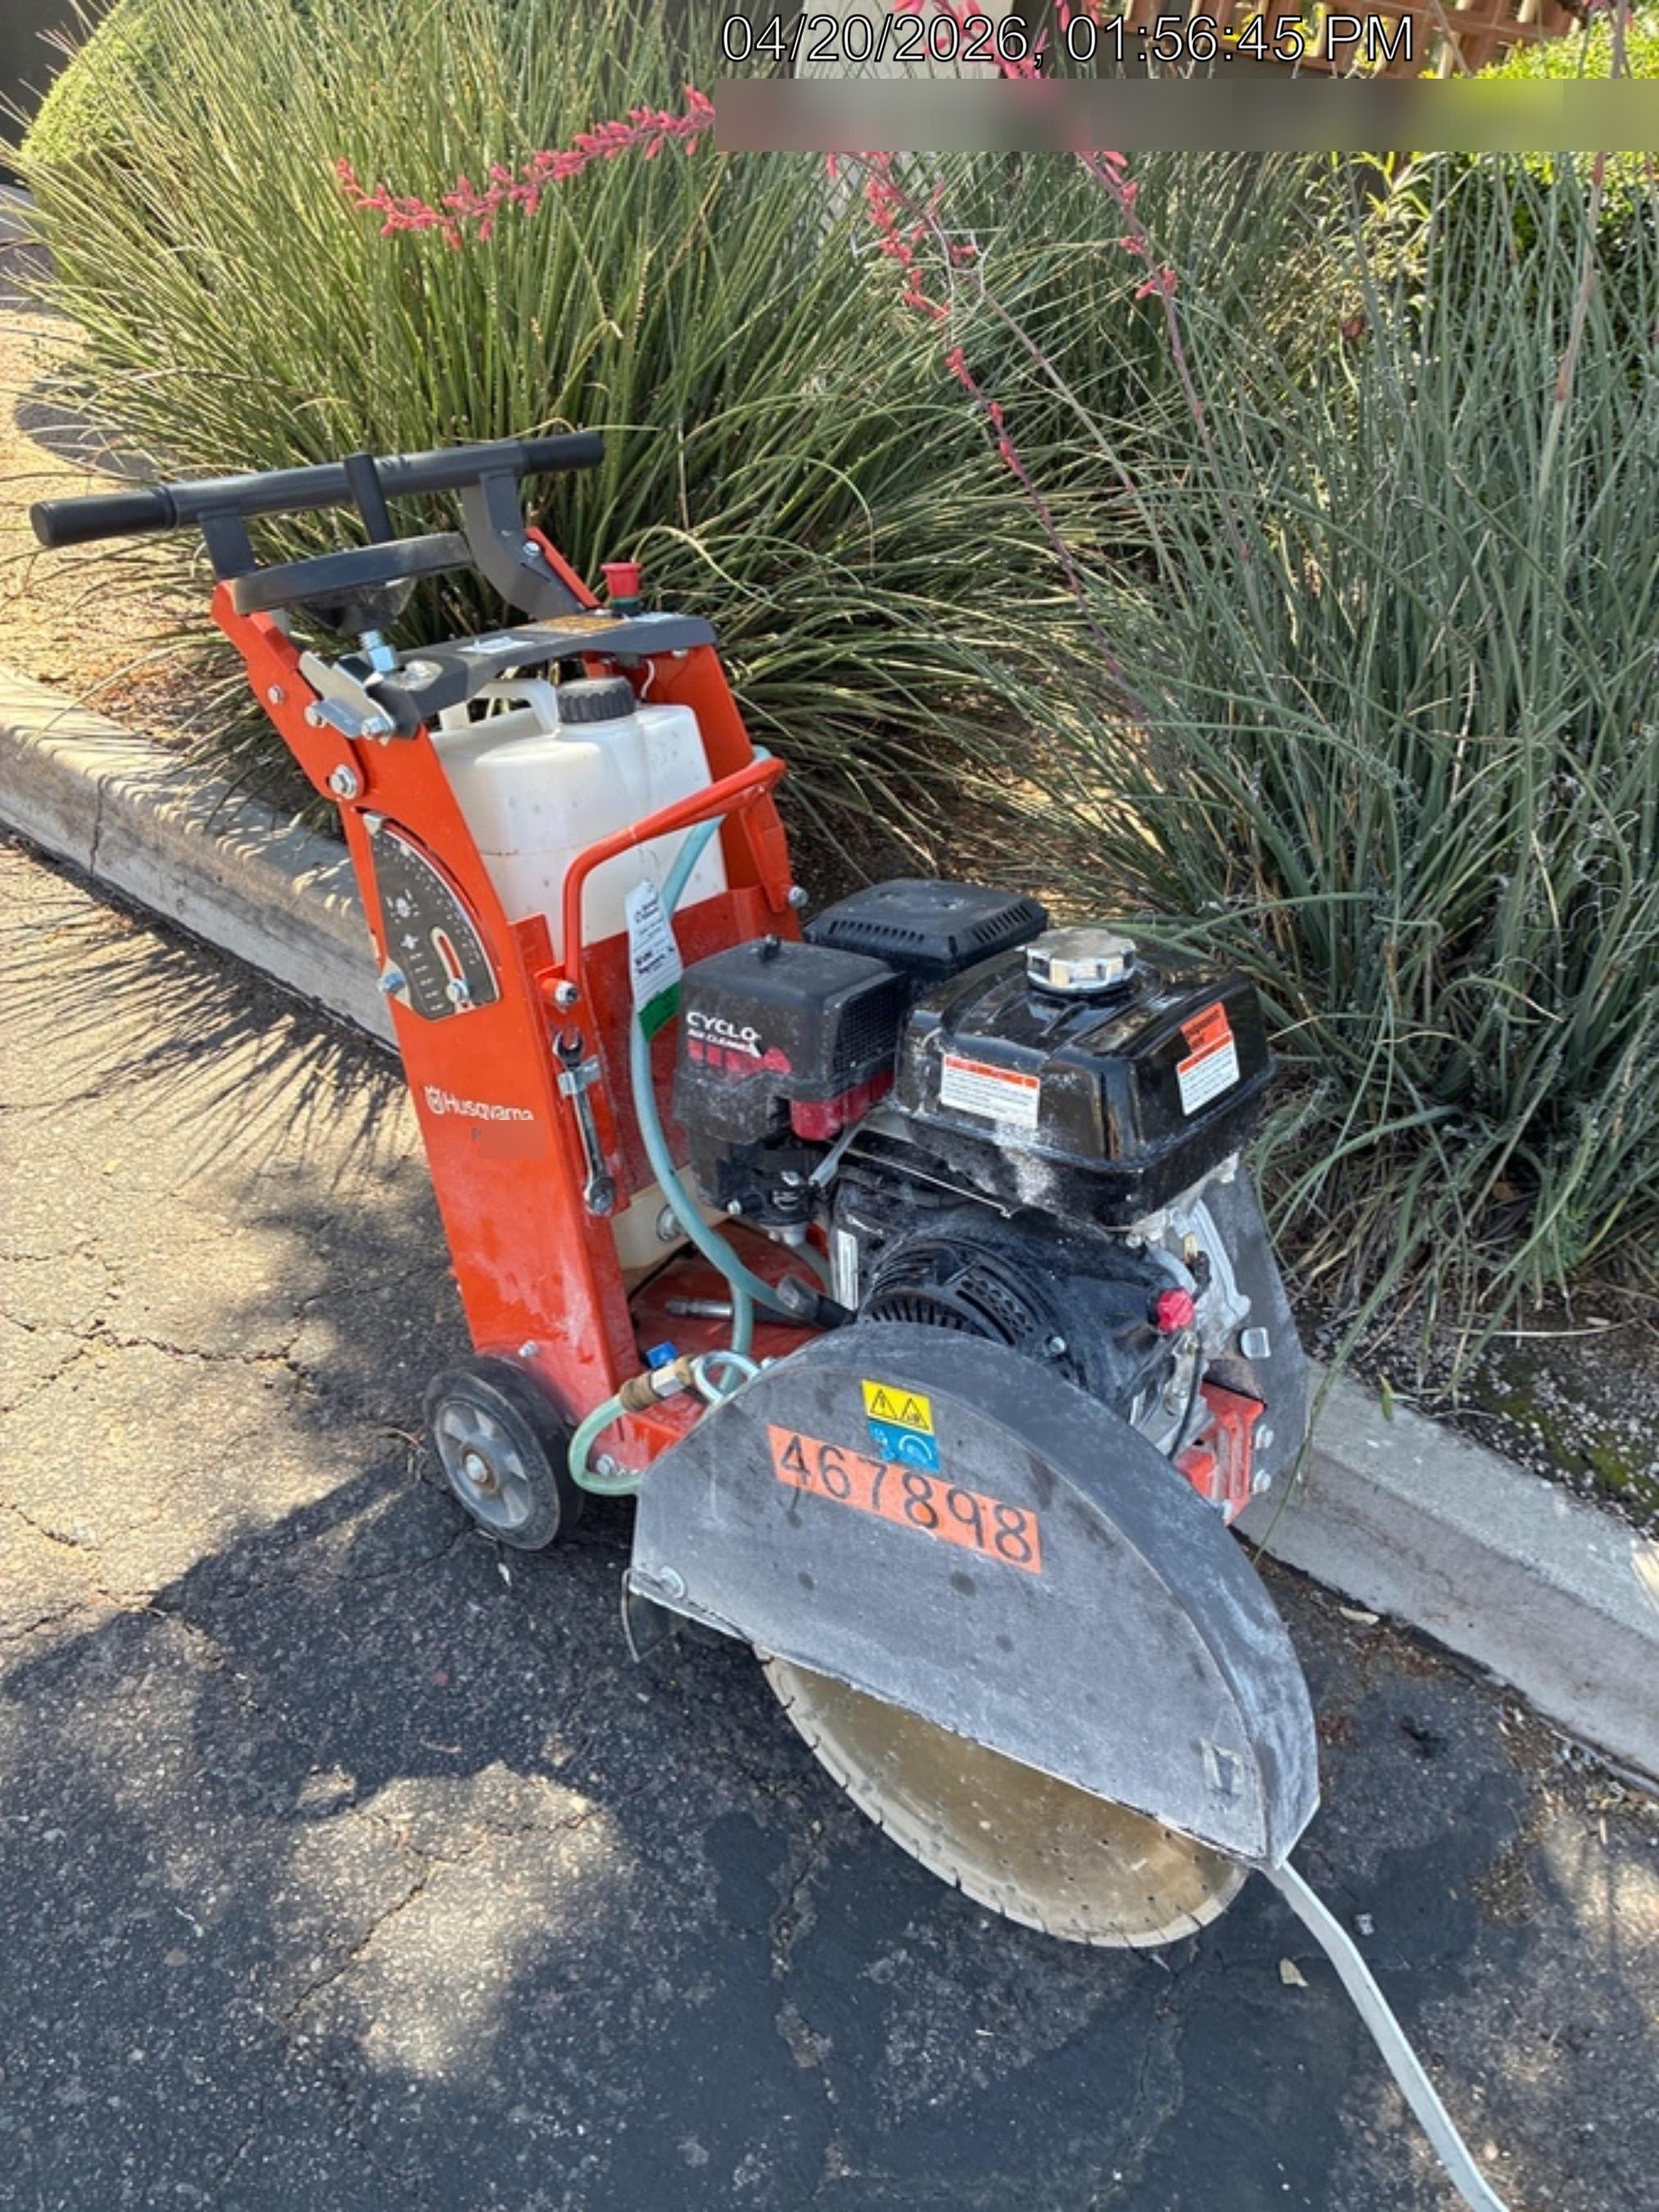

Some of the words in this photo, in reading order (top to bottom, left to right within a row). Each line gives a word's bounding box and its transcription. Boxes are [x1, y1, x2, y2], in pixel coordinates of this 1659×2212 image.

[686, 1011, 761, 1043] CYCLO
[442, 1090, 535, 1121] Husqvarna
[781, 1435, 1034, 1564] 467898
